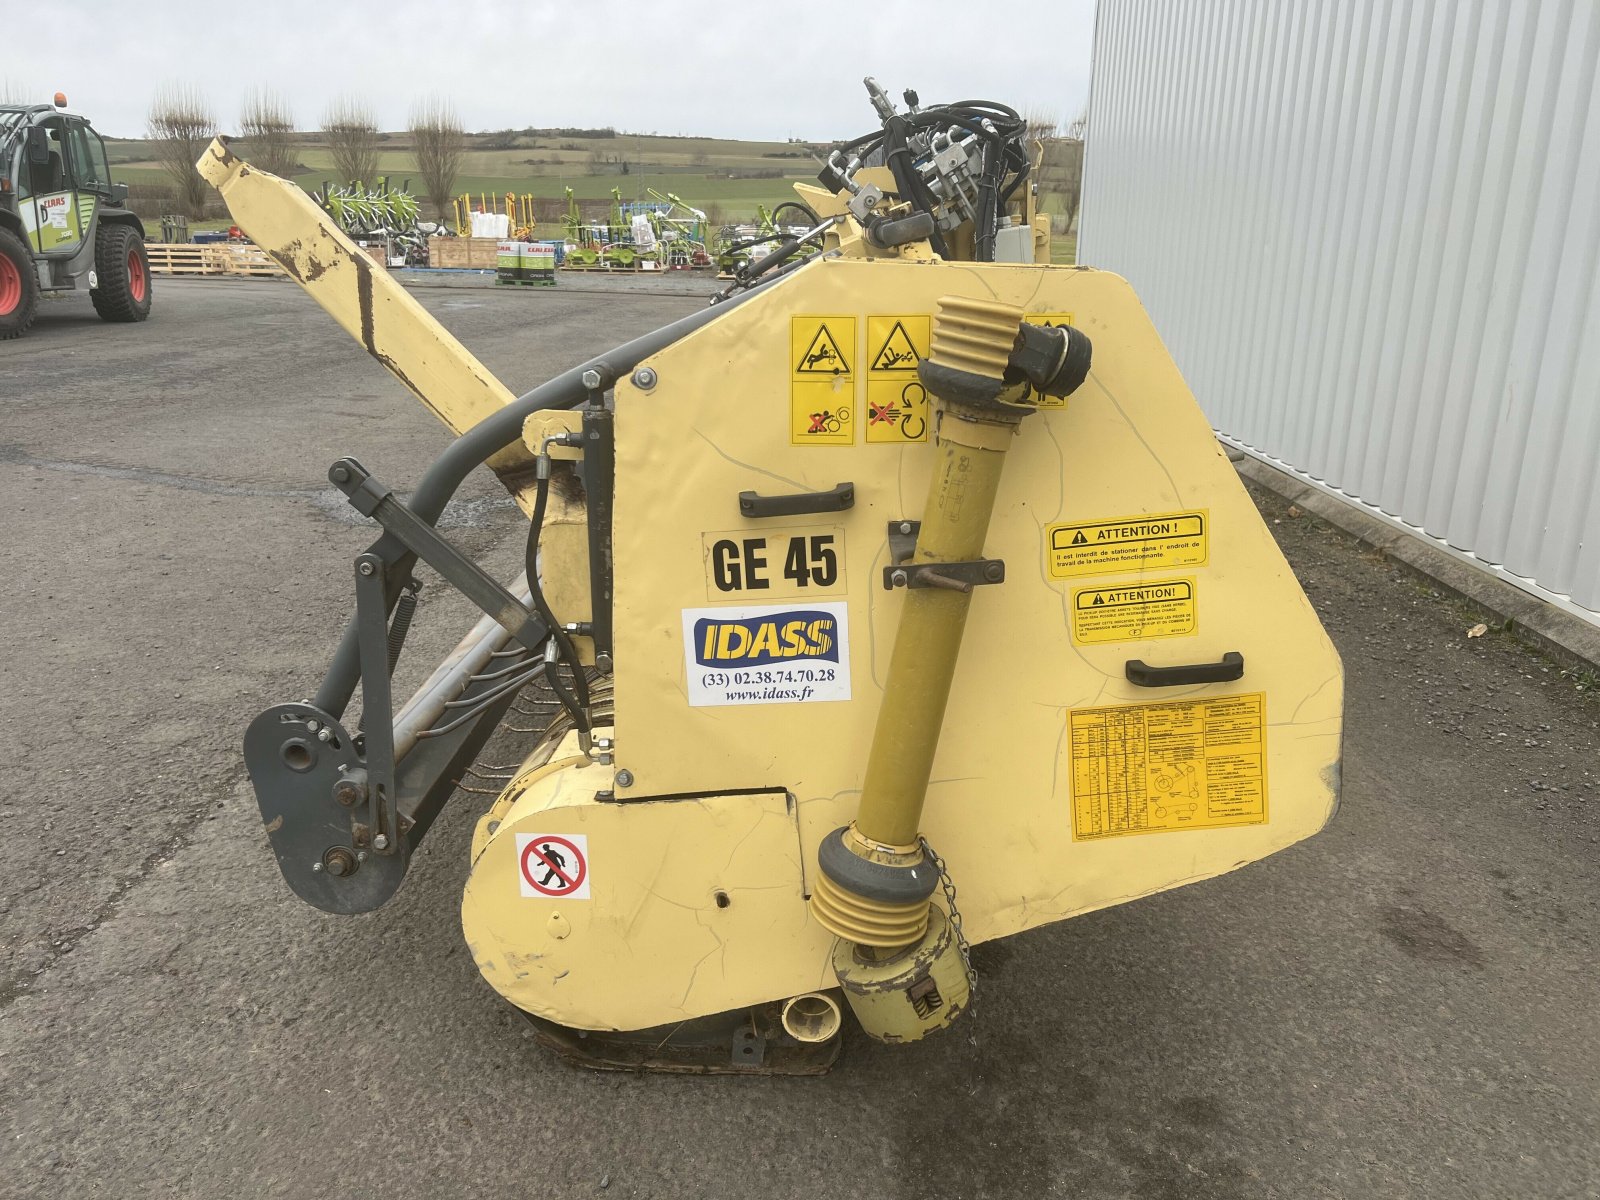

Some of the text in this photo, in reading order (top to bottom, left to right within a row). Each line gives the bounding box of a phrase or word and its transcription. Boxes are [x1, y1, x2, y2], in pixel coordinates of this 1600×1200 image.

[44, 196, 65, 208] CLAAS
[1098, 524, 1170, 540] ATTENTION
[712, 535, 838, 592] GE 45
[1120, 552, 1164, 560] fonctionnante
[1108, 588, 1175, 602] ATTENTION!
[704, 620, 832, 660] IDASS
[702, 668, 835, 688] (33) 02.38.74.70.28
[726, 686, 814, 701] www.idass.fr
